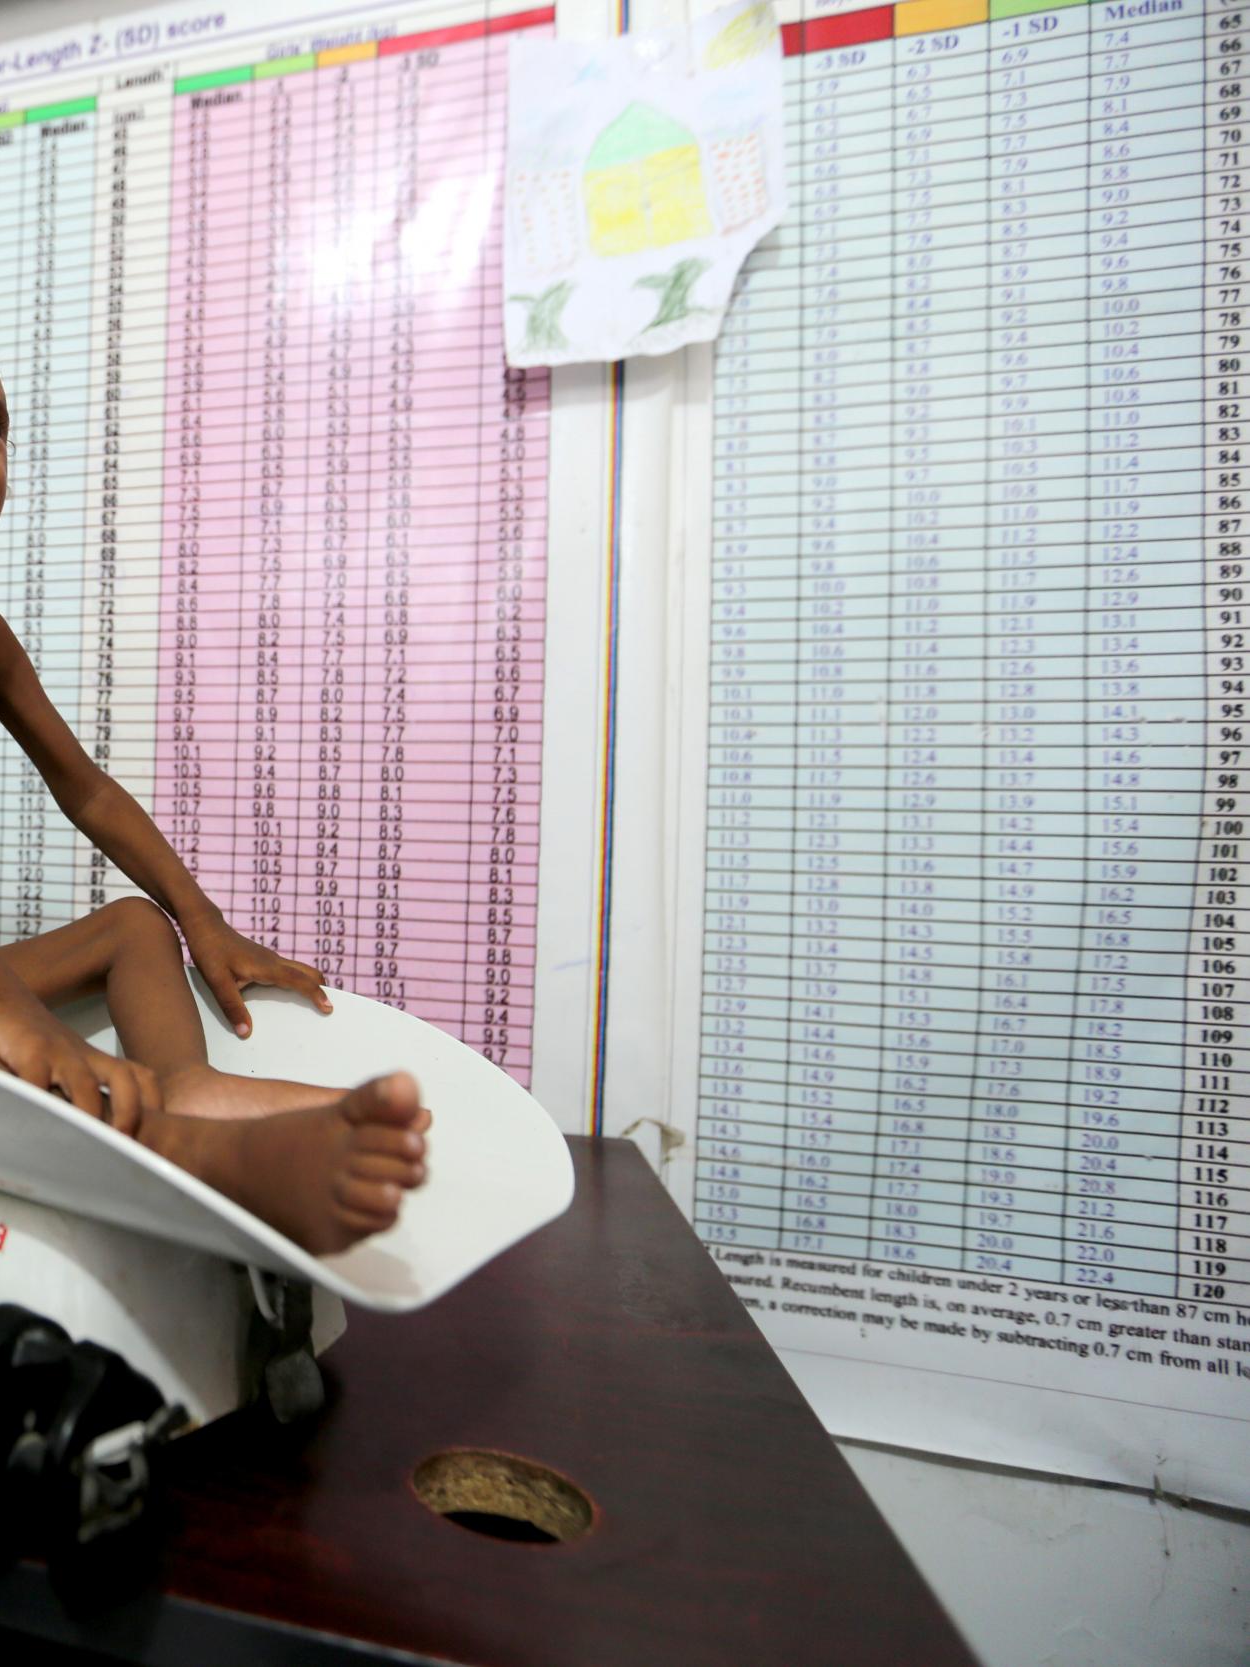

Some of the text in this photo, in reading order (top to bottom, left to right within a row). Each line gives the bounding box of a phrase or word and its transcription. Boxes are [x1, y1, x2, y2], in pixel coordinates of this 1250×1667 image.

[1104, 0, 1183, 22] Median
[1002, 15, 1058, 38] -1 SD
[1220, 15, 1242, 30] 65
[115, 22, 160, 56] (SD)
[167, 12, 226, 37] score
[908, 34, 959, 55] -2 SD
[1220, 38, 1241, 53] 66
[839, 51, 867, 67] SD
[1220, 83, 1241, 99] 68
[1105, 99, 1129, 113] 8.1
[1220, 105, 1242, 122] 69
[1220, 150, 1242, 167] 71
[1103, 166, 1129, 181] 8.8
[1220, 173, 1241, 190] 72
[1220, 218, 1241, 236] 74
[1103, 233, 1129, 248] 9.4
[1220, 241, 1241, 259] 75
[1219, 287, 1240, 305] 77
[1102, 298, 1140, 314] 10.0
[1219, 310, 1240, 328] 78
[1102, 366, 1140, 381] 10.6
[1219, 357, 1240, 374] 80
[1219, 379, 1240, 397] 81
[1102, 433, 1138, 448] 11.2
[1219, 425, 1240, 443] 83
[1219, 448, 1240, 465] 84
[1103, 501, 1139, 517] 11.9
[1219, 494, 1242, 512] 86
[1219, 517, 1242, 535] 87
[1102, 568, 1139, 584] 12.6
[1219, 563, 1243, 581] 89
[496, 585, 522, 601] 6.0
[1219, 586, 1244, 604] 90
[99, 601, 114, 614] 72
[496, 626, 522, 641] 6.3
[1220, 632, 1244, 650] 92
[98, 636, 113, 650] 74
[1102, 636, 1139, 652] 13.4
[1220, 655, 1244, 673] 93
[96, 672, 112, 686] 76
[496, 667, 520, 681] 6.6
[174, 689, 196, 703] 9.5
[256, 688, 277, 702] 8.7
[320, 688, 343, 702] 8.0
[384, 687, 406, 702] 7.4
[96, 708, 111, 722] 78
[494, 707, 519, 722] 6.9
[1102, 704, 1139, 719] 14.1
[1221, 702, 1245, 719] 95
[95, 726, 110, 740] 79
[1221, 725, 1243, 743] 96
[494, 747, 517, 762] 7.1
[174, 764, 201, 778] 10.3
[381, 766, 404, 781] 8.0
[493, 766, 517, 782] 7.3
[1102, 772, 1139, 788] 14.8
[1218, 773, 1239, 790] 98
[253, 802, 274, 816] 9.8
[318, 805, 340, 820] 9.0
[1216, 797, 1237, 814] 99
[492, 808, 516, 823] 7.6
[378, 845, 401, 859] 8.7
[1101, 840, 1137, 856] 15.6
[1212, 843, 1241, 860] 101
[490, 849, 515, 864] 8.0
[18, 868, 43, 882] 12.0
[91, 871, 105, 885] 87
[1209, 866, 1239, 883] 102
[17, 886, 42, 900] 12.2
[378, 883, 399, 898] 9.1
[490, 888, 513, 903] 8.3
[1097, 908, 1132, 925] 16.5
[1204, 912, 1236, 929] 104
[315, 919, 345, 934] 10.3
[488, 930, 512, 944] 8.7
[1202, 935, 1234, 952] 105
[375, 962, 397, 976] 9.9
[486, 969, 511, 984] 9.0
[1091, 977, 1126, 993] 17.5
[1202, 982, 1235, 999] 107
[484, 1009, 509, 1024] 9.4
[1201, 1005, 1234, 1022] 108
[1086, 1043, 1121, 1060] 18.5
[1200, 1051, 1232, 1068] 110
[1199, 1074, 1231, 1091] 111
[1082, 1111, 1118, 1128] 19.6
[1196, 1120, 1230, 1138] 113
[1195, 1143, 1229, 1161] 114
[1080, 1179, 1116, 1196] 20.8
[1194, 1190, 1228, 1208] 116
[1193, 1213, 1228, 1231] 117
[1077, 1245, 1114, 1262] 22.0
[1193, 1259, 1225, 1276] 119
[1077, 1268, 1113, 1284] 22.4
[715, 1249, 764, 1266] Length
[770, 1254, 781, 1266] is
[786, 1258, 856, 1276] measured
[862, 1264, 882, 1278] for
[888, 1268, 952, 1287] children
[957, 1277, 1003, 1294] under
[1008, 1282, 1018, 1296] 2
[1023, 1288, 1068, 1302] years
[1073, 1293, 1089, 1306] or
[1133, 1299, 1170, 1316] than
[1176, 1304, 1198, 1319] 87
[1204, 1311, 1230, 1324] cm
[1192, 1282, 1224, 1300] 120
[781, 1276, 866, 1300] Recumbent
[870, 1288, 917, 1308] length
[923, 1295, 940, 1311] is,
[946, 1302, 965, 1313] on
[971, 1305, 1040, 1325] average,
[1044, 1312, 1071, 1327] 0.7
[1076, 1318, 1103, 1332] cm
[1109, 1322, 1168, 1340] greater
[1173, 1330, 1210, 1347] than
[769, 1301, 777, 1310] a
[782, 1302, 857, 1321] correction
[862, 1312, 895, 1329] may
[900, 1315, 920, 1330] be
[924, 1321, 967, 1336] made
[972, 1326, 992, 1343] by
[997, 1330, 1090, 1358] subtracting
[1094, 1342, 1120, 1359] 0.7
[1126, 1350, 1153, 1364] cm
[1160, 1351, 1200, 1370] from
[1207, 1359, 1229, 1376] all
